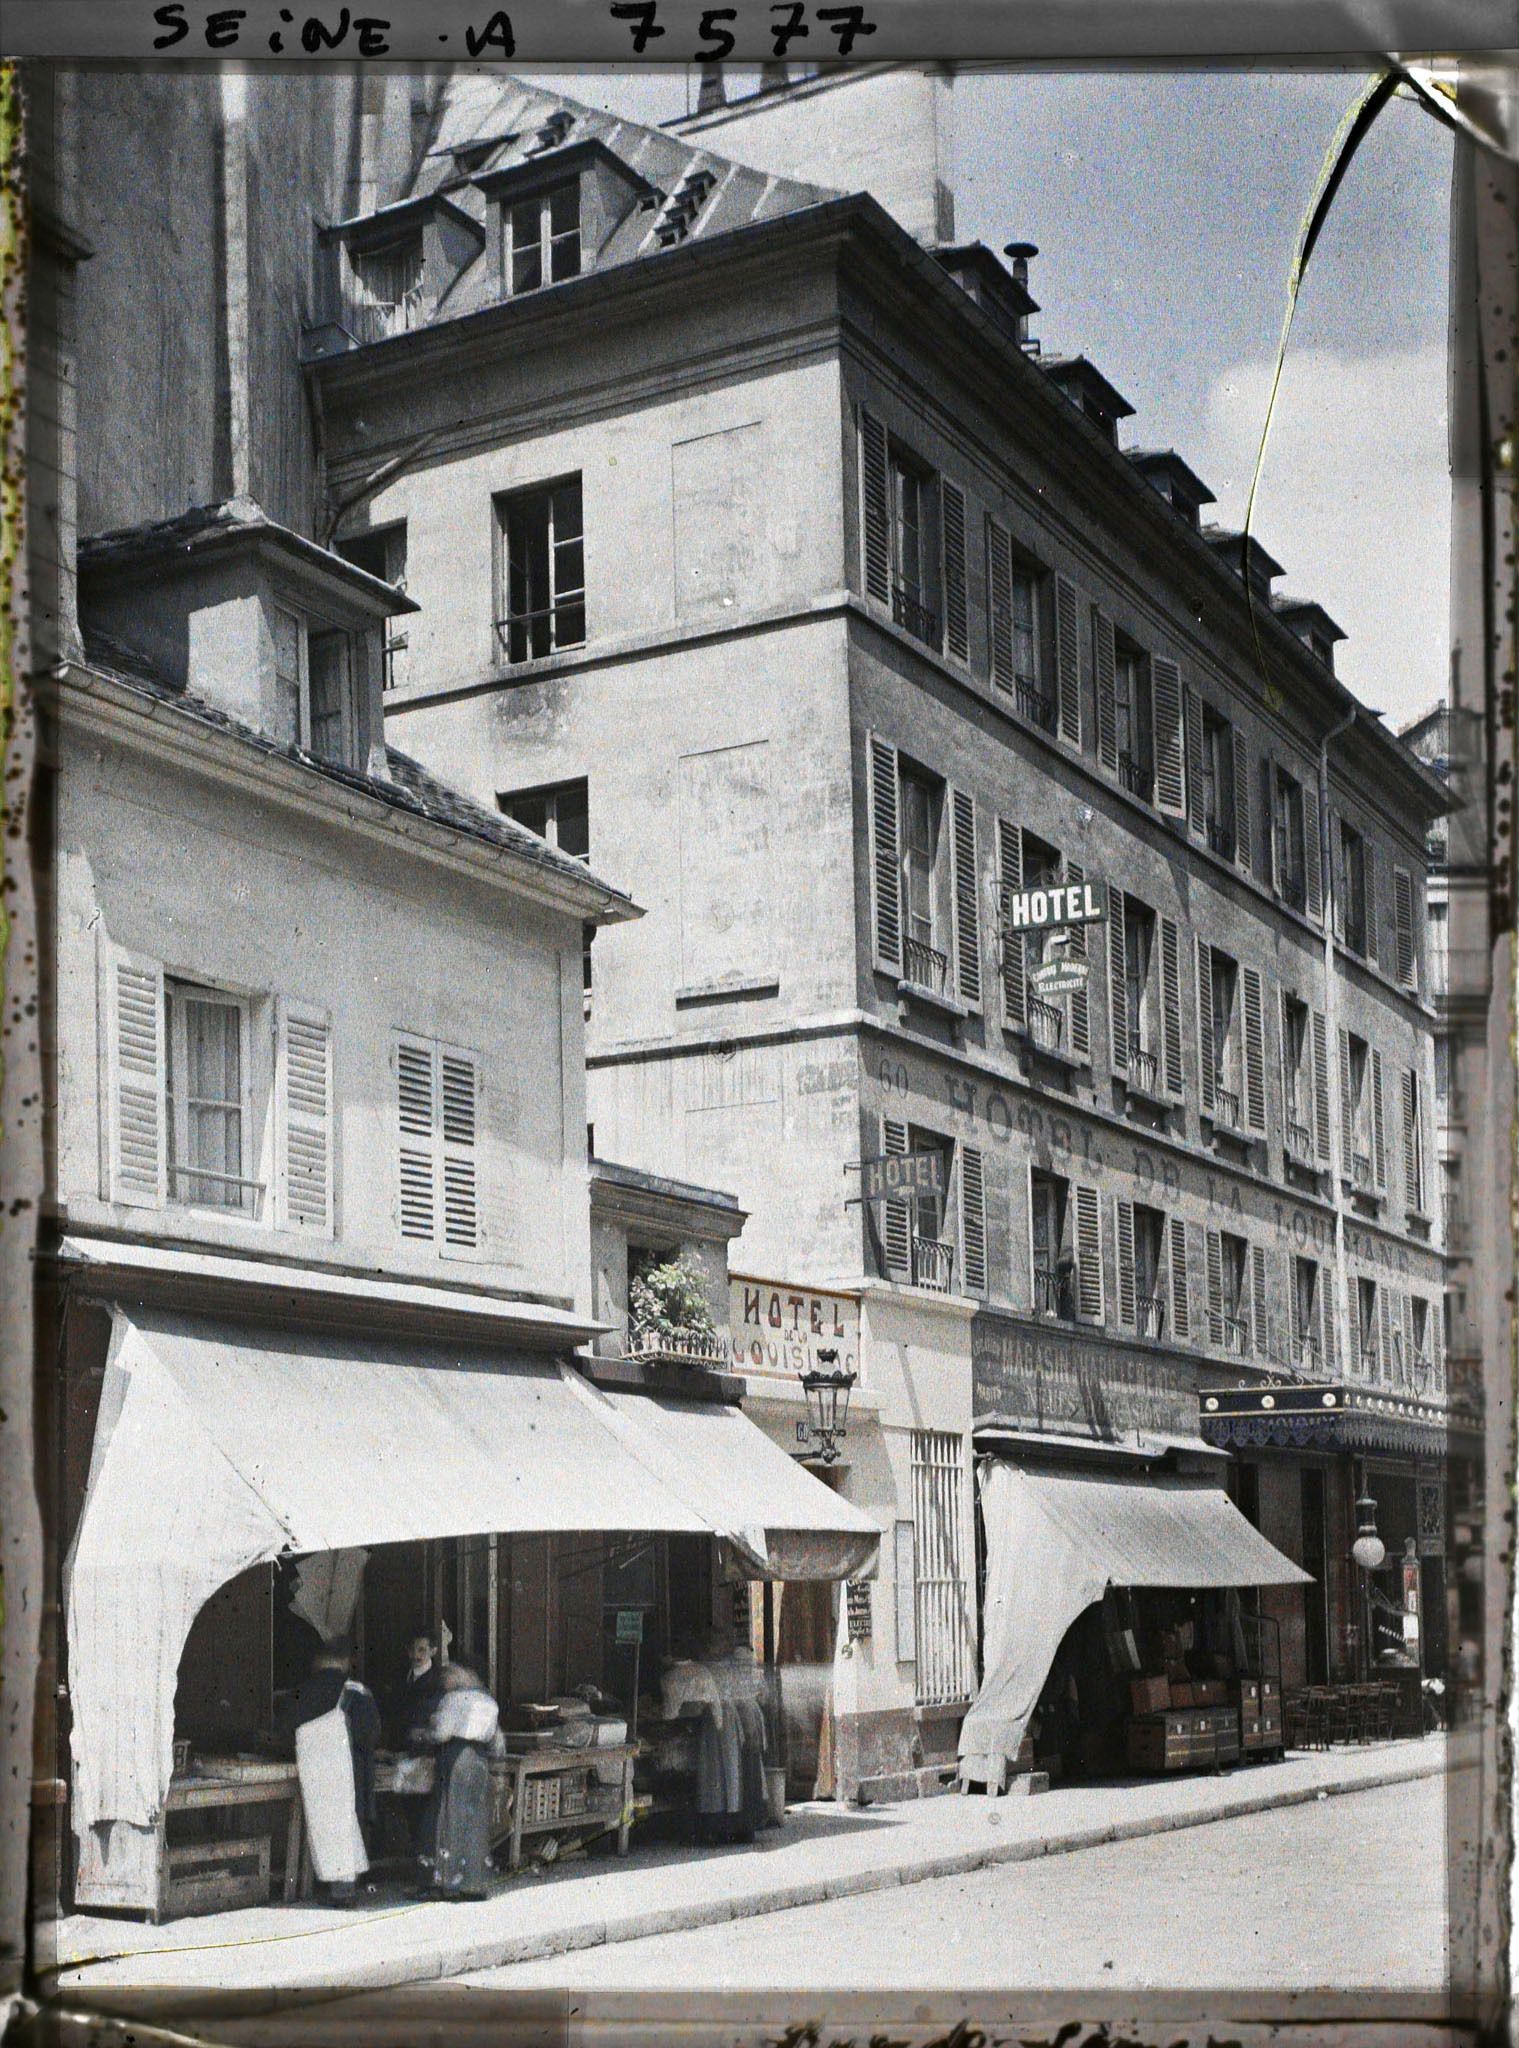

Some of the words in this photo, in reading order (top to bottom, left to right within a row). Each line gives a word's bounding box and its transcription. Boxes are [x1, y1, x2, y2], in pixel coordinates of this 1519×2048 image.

[609, 2, 878, 62] 7577
[1012, 884, 1101, 927] HOTEL
[879, 1058, 909, 1099] 60
[1132, 1148, 1182, 1203] DE
[1207, 1175, 1244, 1215] LA
[868, 1155, 943, 1196] HOTEL
